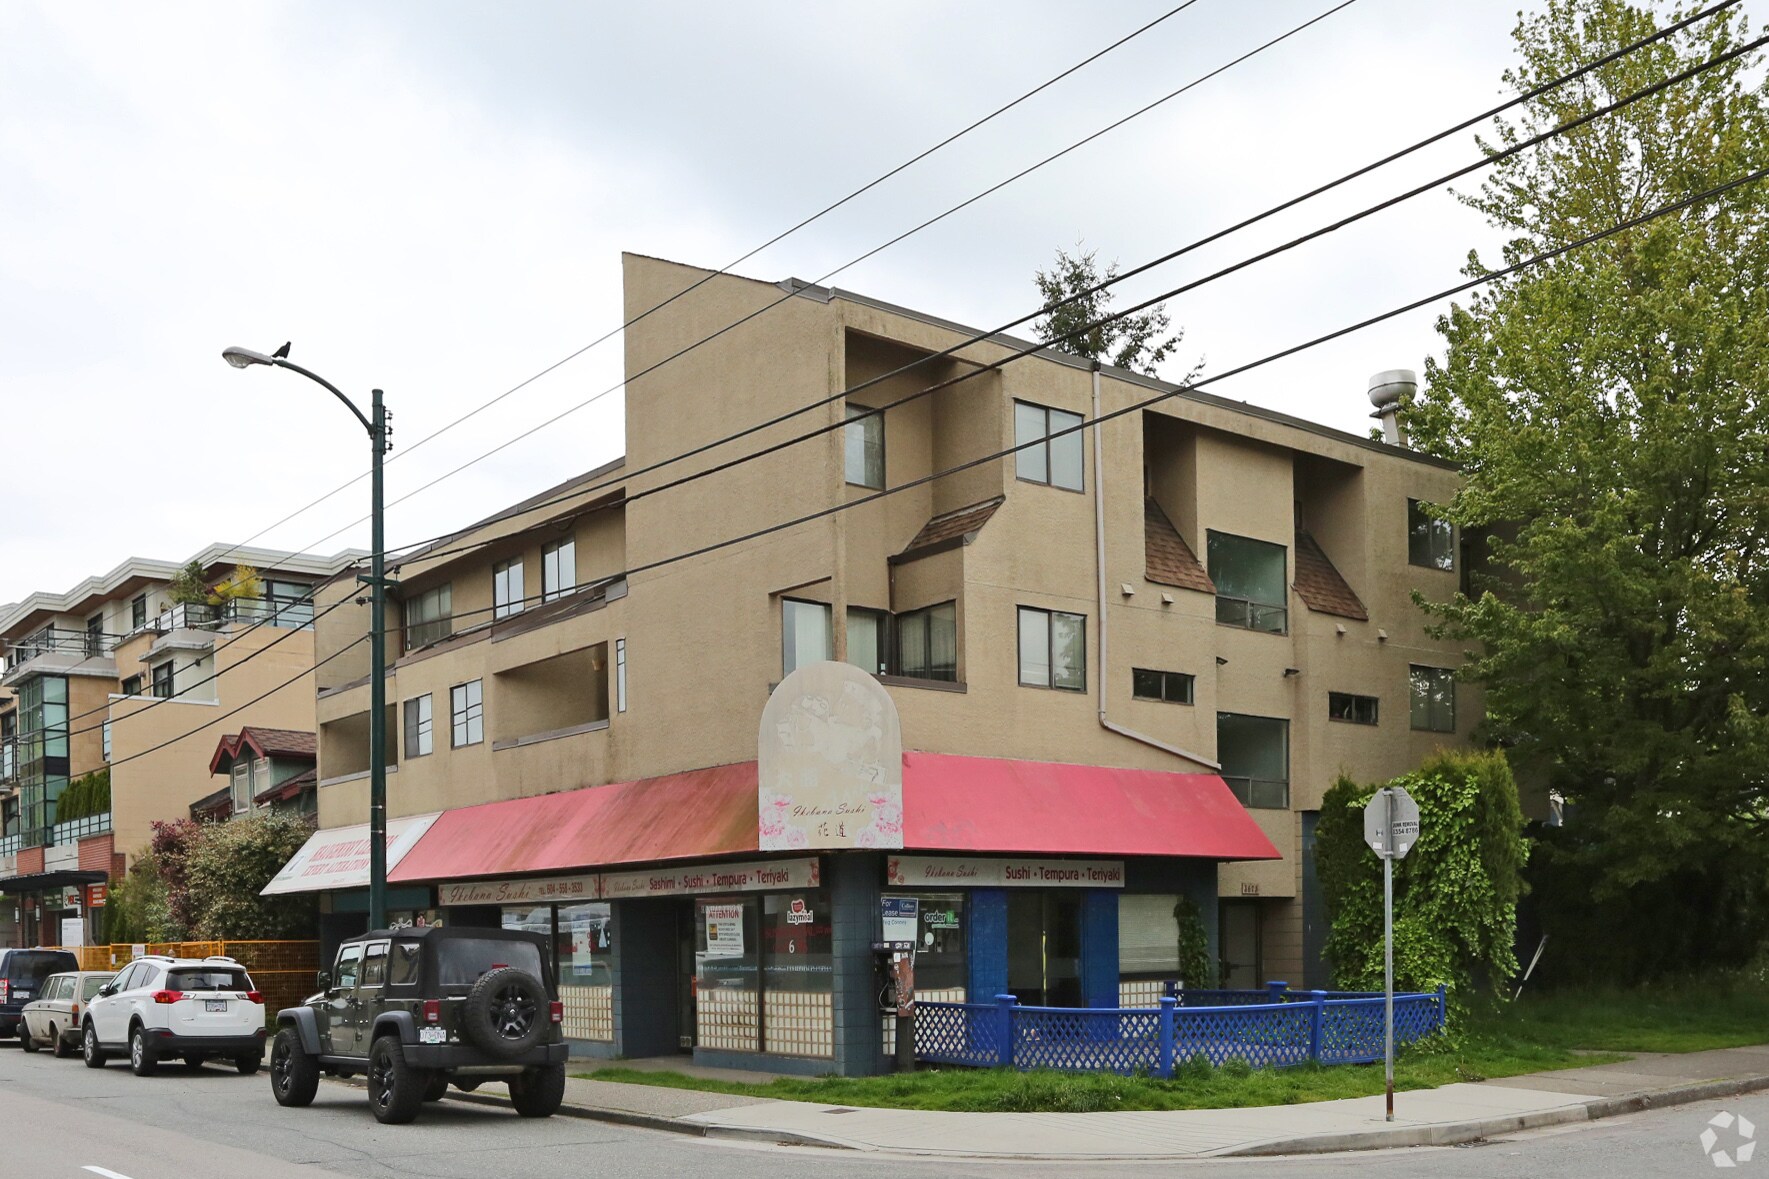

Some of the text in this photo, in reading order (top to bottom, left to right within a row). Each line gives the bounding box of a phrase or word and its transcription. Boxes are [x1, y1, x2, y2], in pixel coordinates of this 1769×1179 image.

[835, 803, 866, 816] Sushi
[649, 877, 676, 890] Sashimi
[683, 875, 704, 888] Sushi
[712, 872, 747, 888] Tempura
[756, 868, 789, 885] Teriyaki
[957, 865, 978, 878] Sushi
[1005, 865, 1031, 880] Sushi
[1039, 867, 1080, 883] Tempura
[1087, 866, 1121, 884] Teriyaki
[495, 882, 532, 902] Sushi
[882, 899, 892, 907] For
[709, 910, 739, 919] ATTENTION
[925, 910, 946, 922] order
